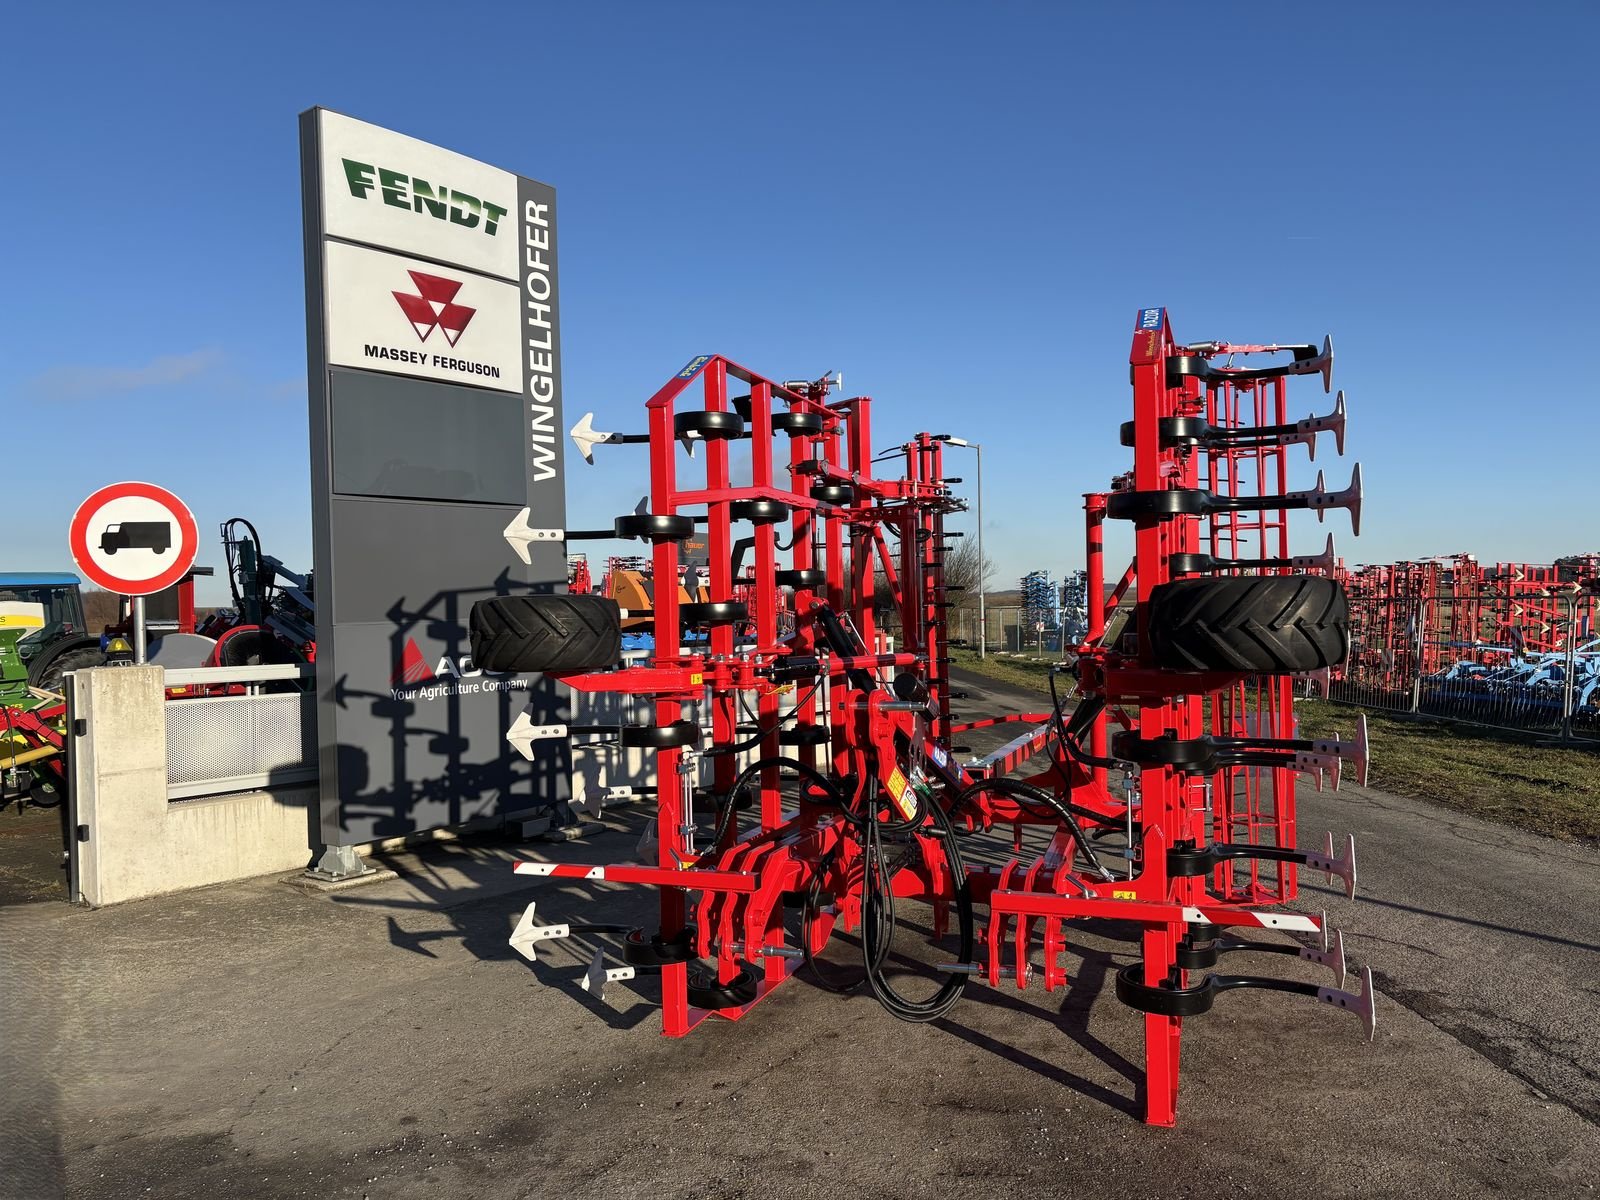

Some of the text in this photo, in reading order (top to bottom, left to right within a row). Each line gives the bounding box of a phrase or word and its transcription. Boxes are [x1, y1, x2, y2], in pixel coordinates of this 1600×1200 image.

[341, 157, 508, 236] FENDT
[525, 199, 557, 482] WINGELHOFER
[364, 344, 500, 379] MASSEY FERGUSON
[434, 655, 506, 680] AG
[391, 679, 528, 701] Your Agriculture Company
